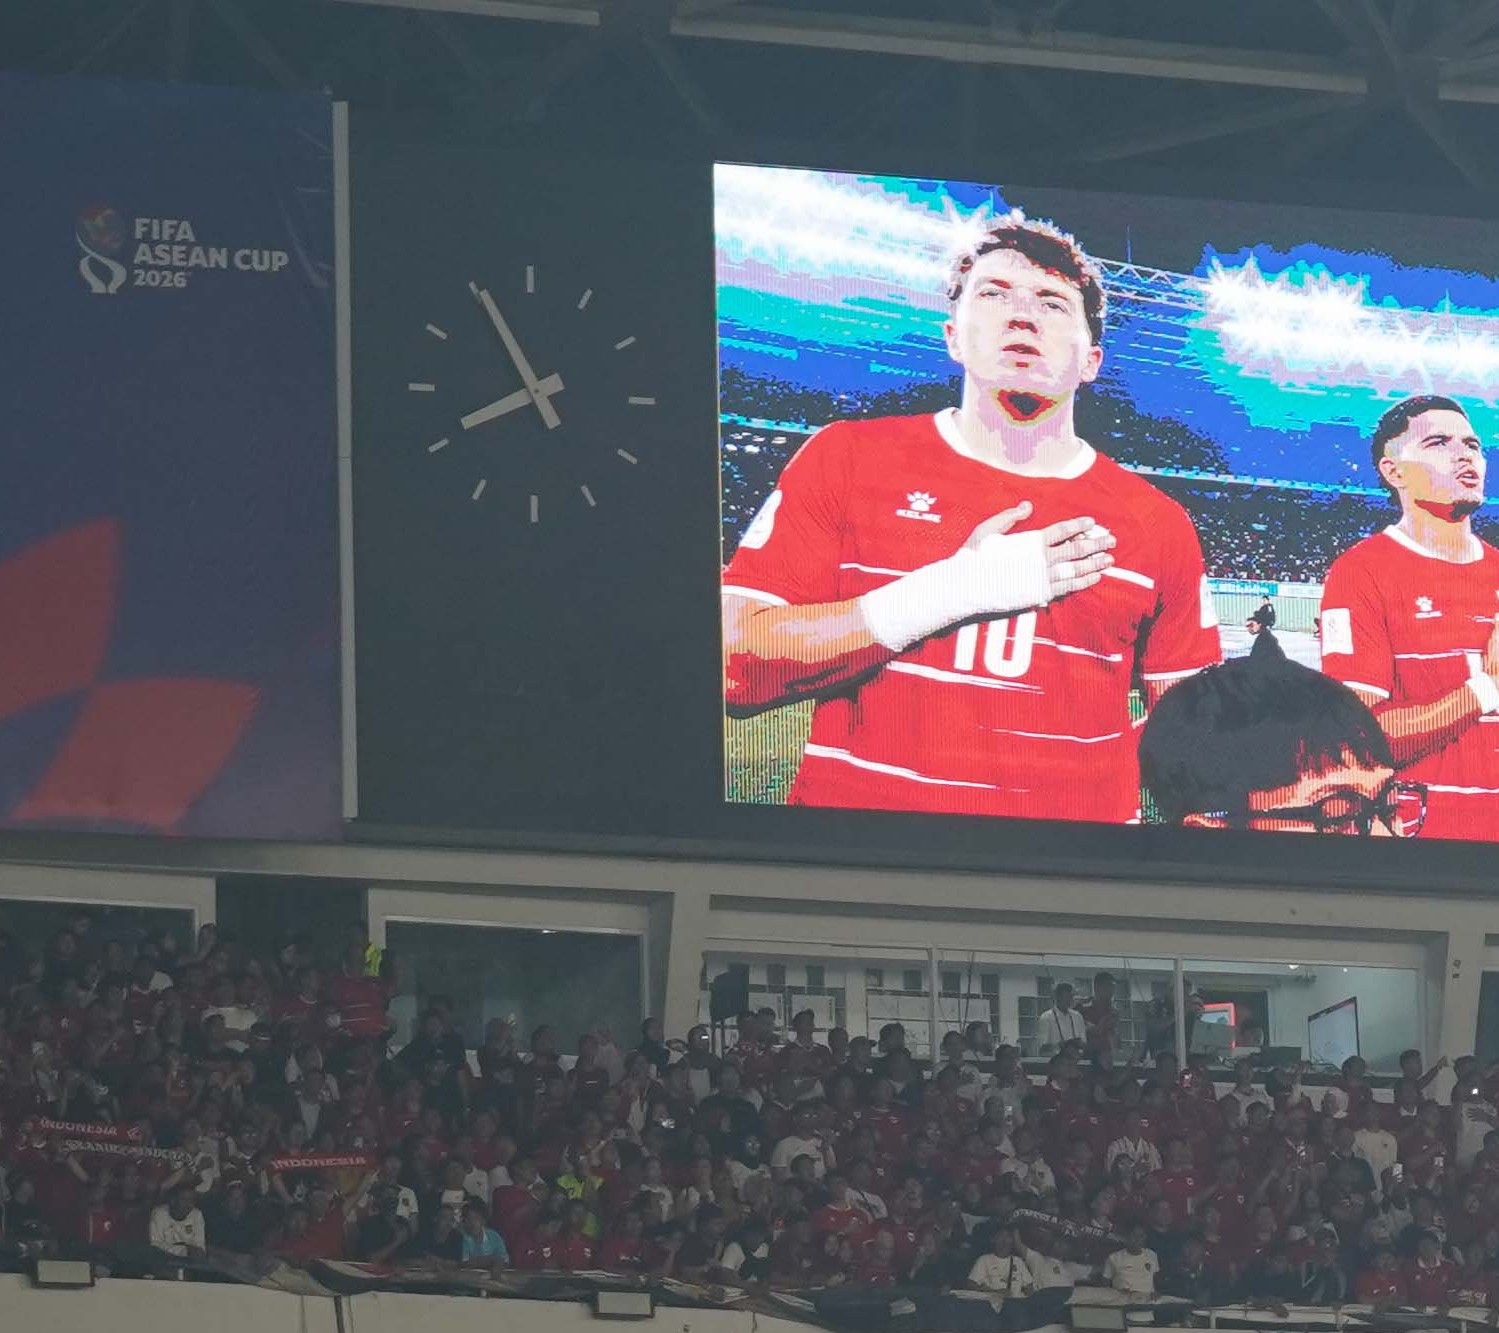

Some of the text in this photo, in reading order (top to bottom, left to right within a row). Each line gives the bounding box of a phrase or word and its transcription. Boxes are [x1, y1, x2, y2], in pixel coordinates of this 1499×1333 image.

[134, 217, 195, 243] FIFA
[134, 244, 289, 274] ASEAN CUP
[134, 269, 188, 289] 2026
[269, 1155, 369, 1171] INDONESIA
